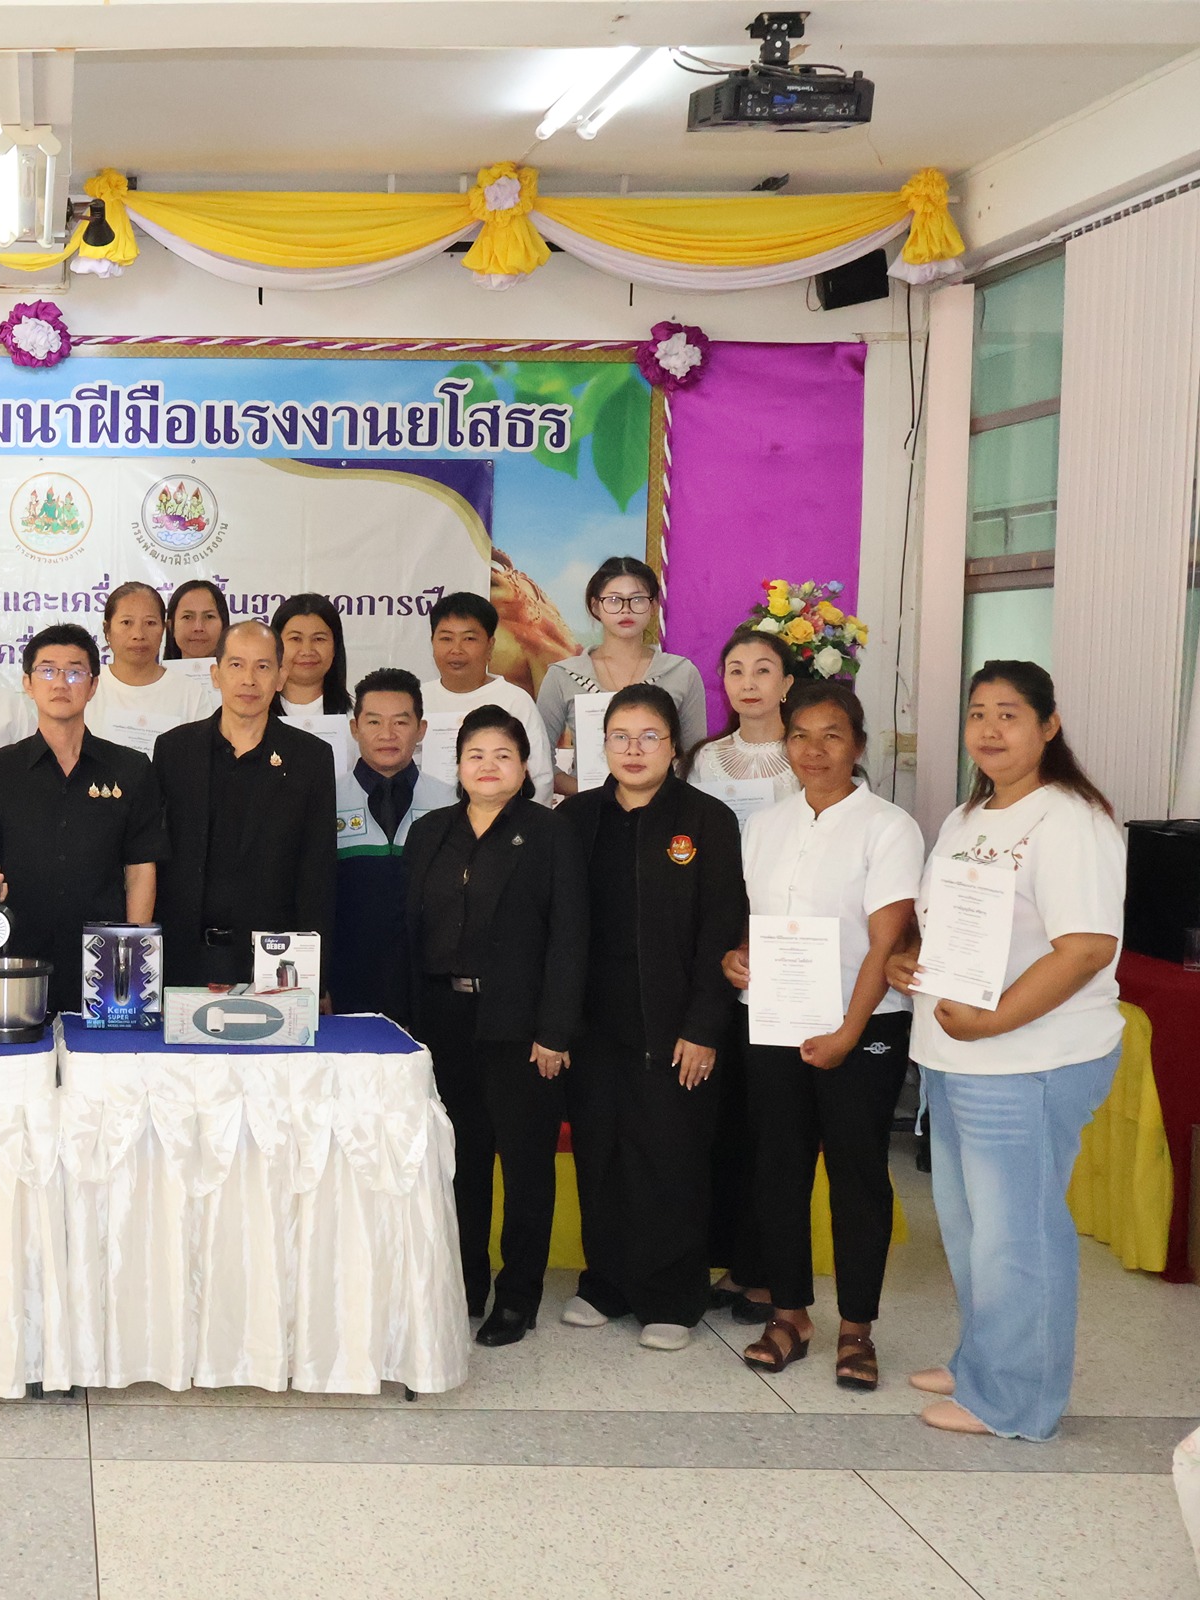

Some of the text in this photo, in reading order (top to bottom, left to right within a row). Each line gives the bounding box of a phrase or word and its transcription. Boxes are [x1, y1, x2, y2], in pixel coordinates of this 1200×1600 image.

[130, 521, 229, 566] กรมพัฒนาฝีมือแรงงาน
